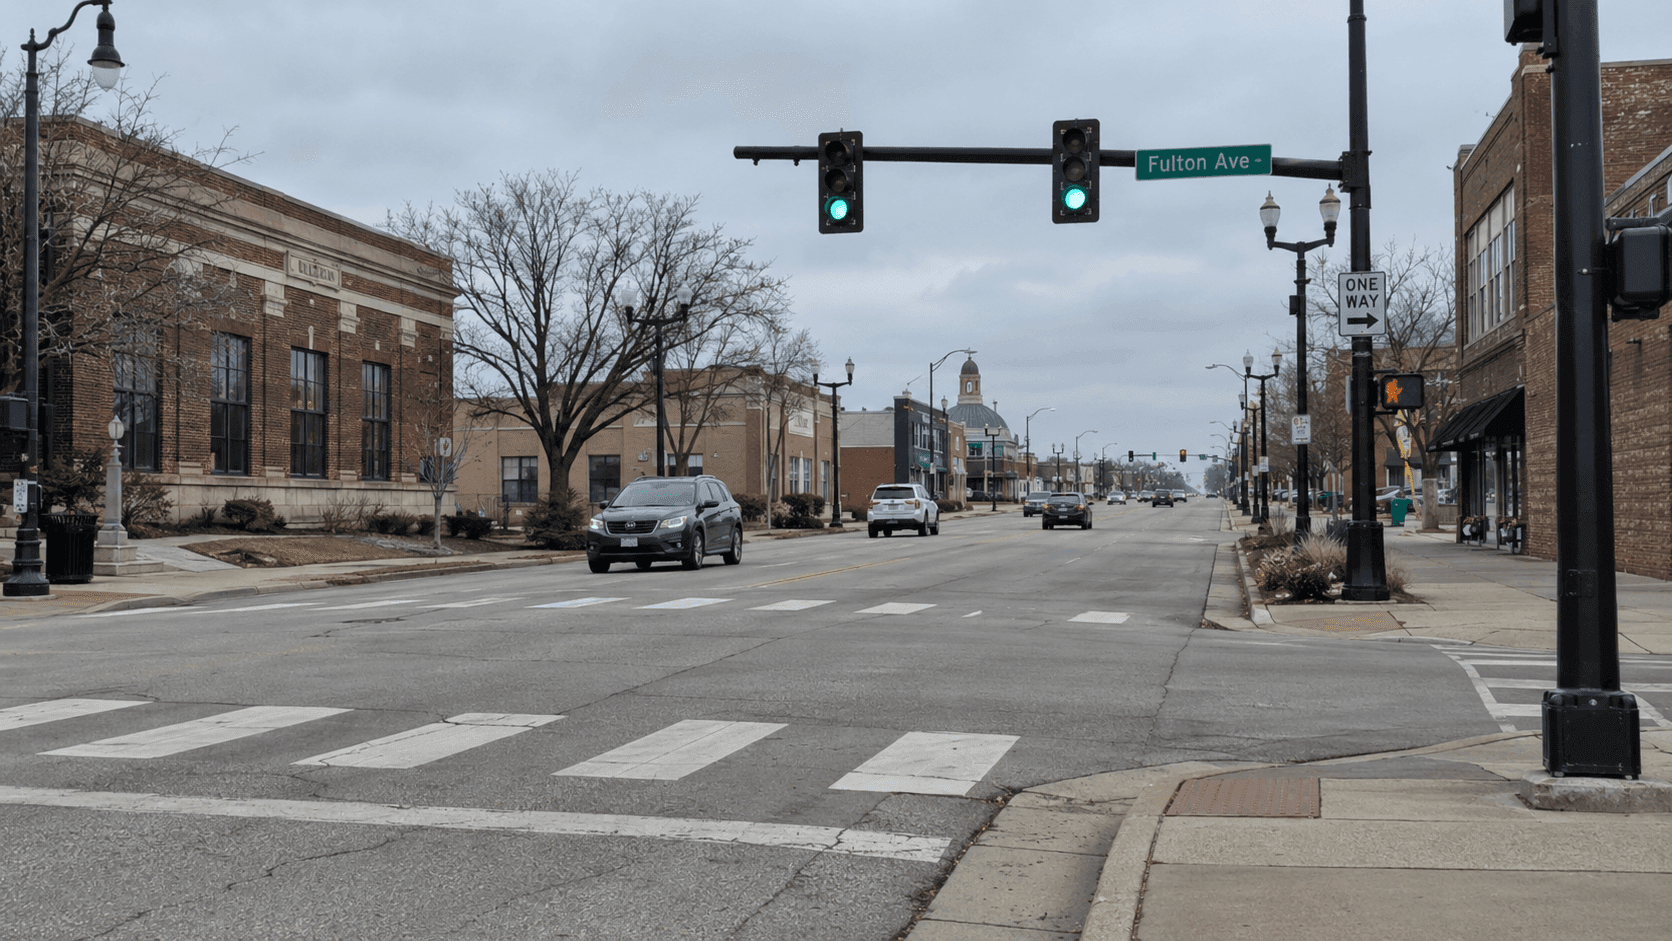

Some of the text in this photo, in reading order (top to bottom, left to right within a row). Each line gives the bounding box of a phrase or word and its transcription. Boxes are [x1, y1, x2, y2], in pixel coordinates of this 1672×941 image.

[1149, 152, 1250, 173] Fulton Ave
[1346, 277, 1379, 291] ONE
[1346, 294, 1379, 308] WAY
